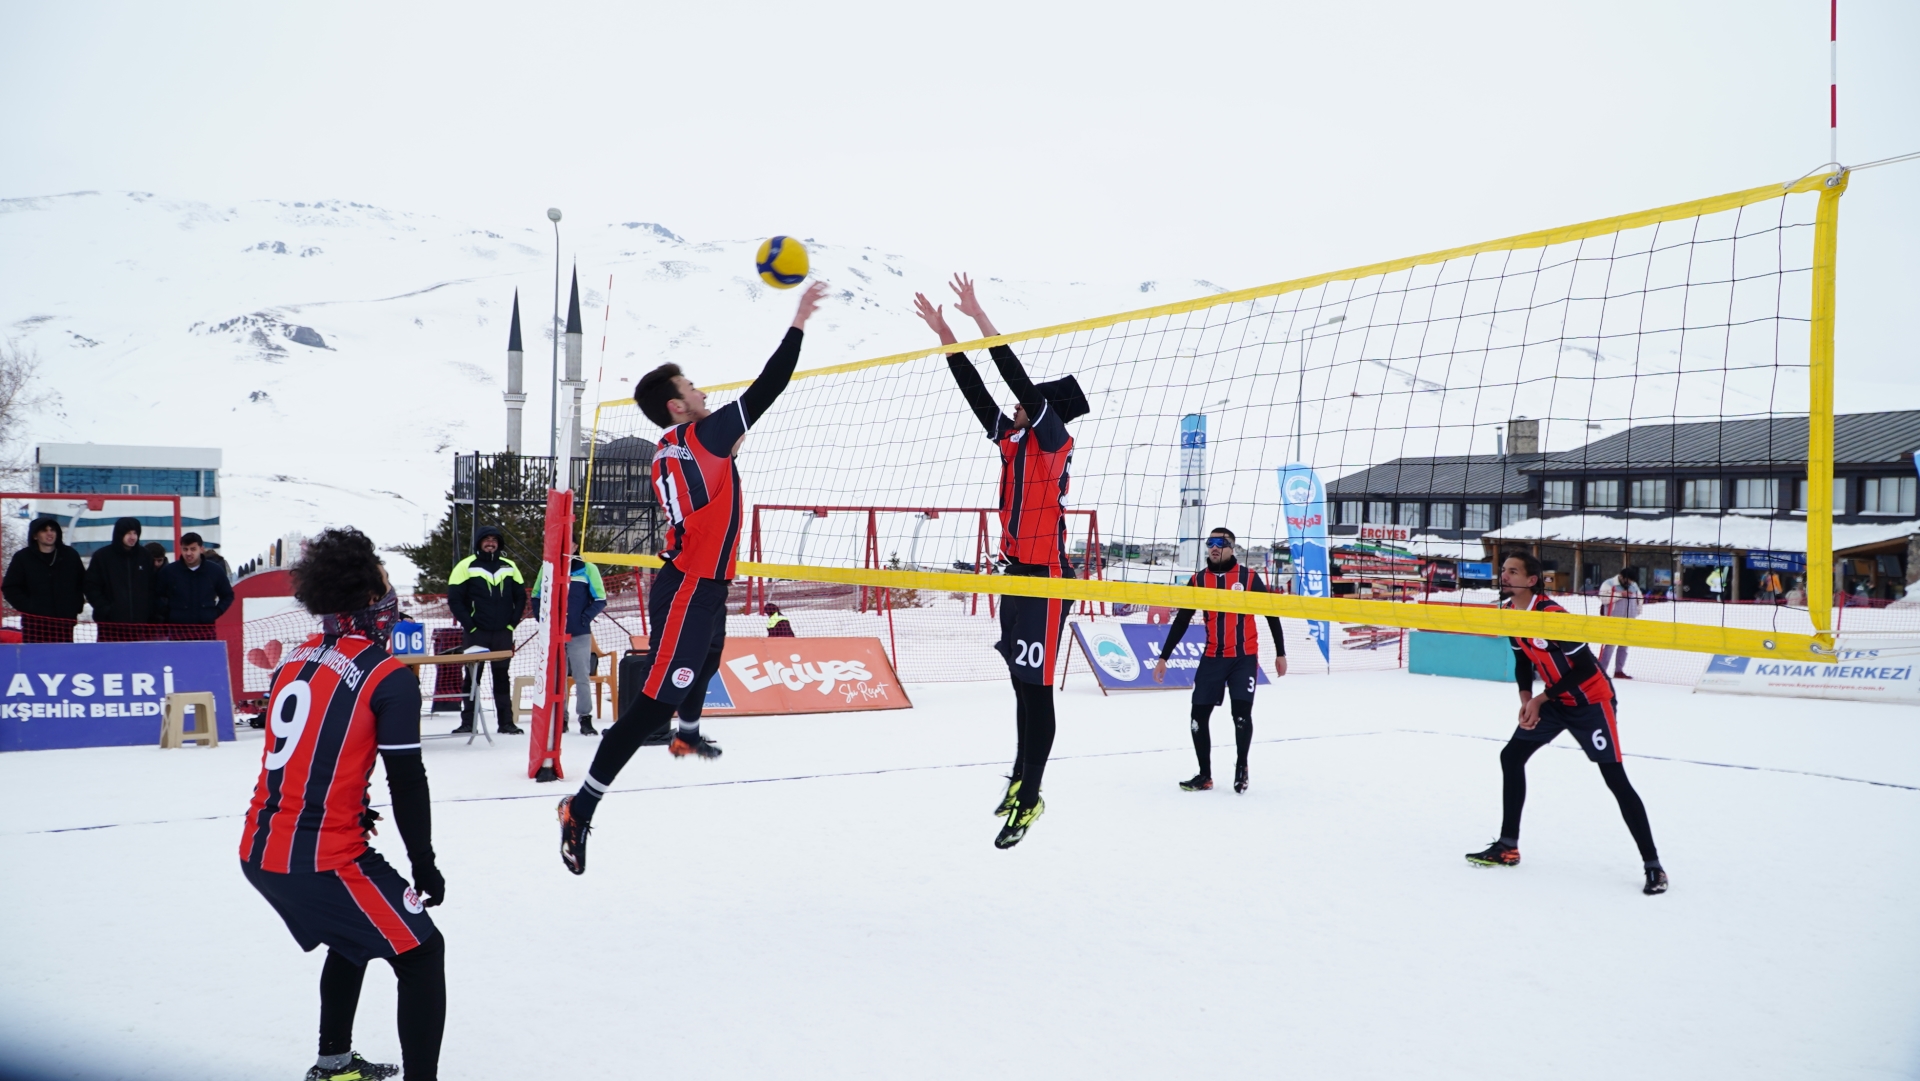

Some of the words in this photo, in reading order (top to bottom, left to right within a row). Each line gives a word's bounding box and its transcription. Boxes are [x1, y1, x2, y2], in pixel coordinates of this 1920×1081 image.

[1361, 526, 1407, 540] ERCİYES
[1015, 638, 1044, 669] 20
[726, 653, 873, 695] Erciyes
[1755, 664, 1816, 678] KAYAK
[1822, 665, 1912, 681] MERKEZİ
[1247, 676, 1256, 693] 3
[0, 699, 86, 722] KŞEHİR
[264, 680, 311, 771] 9
[1592, 728, 1607, 751] 6
